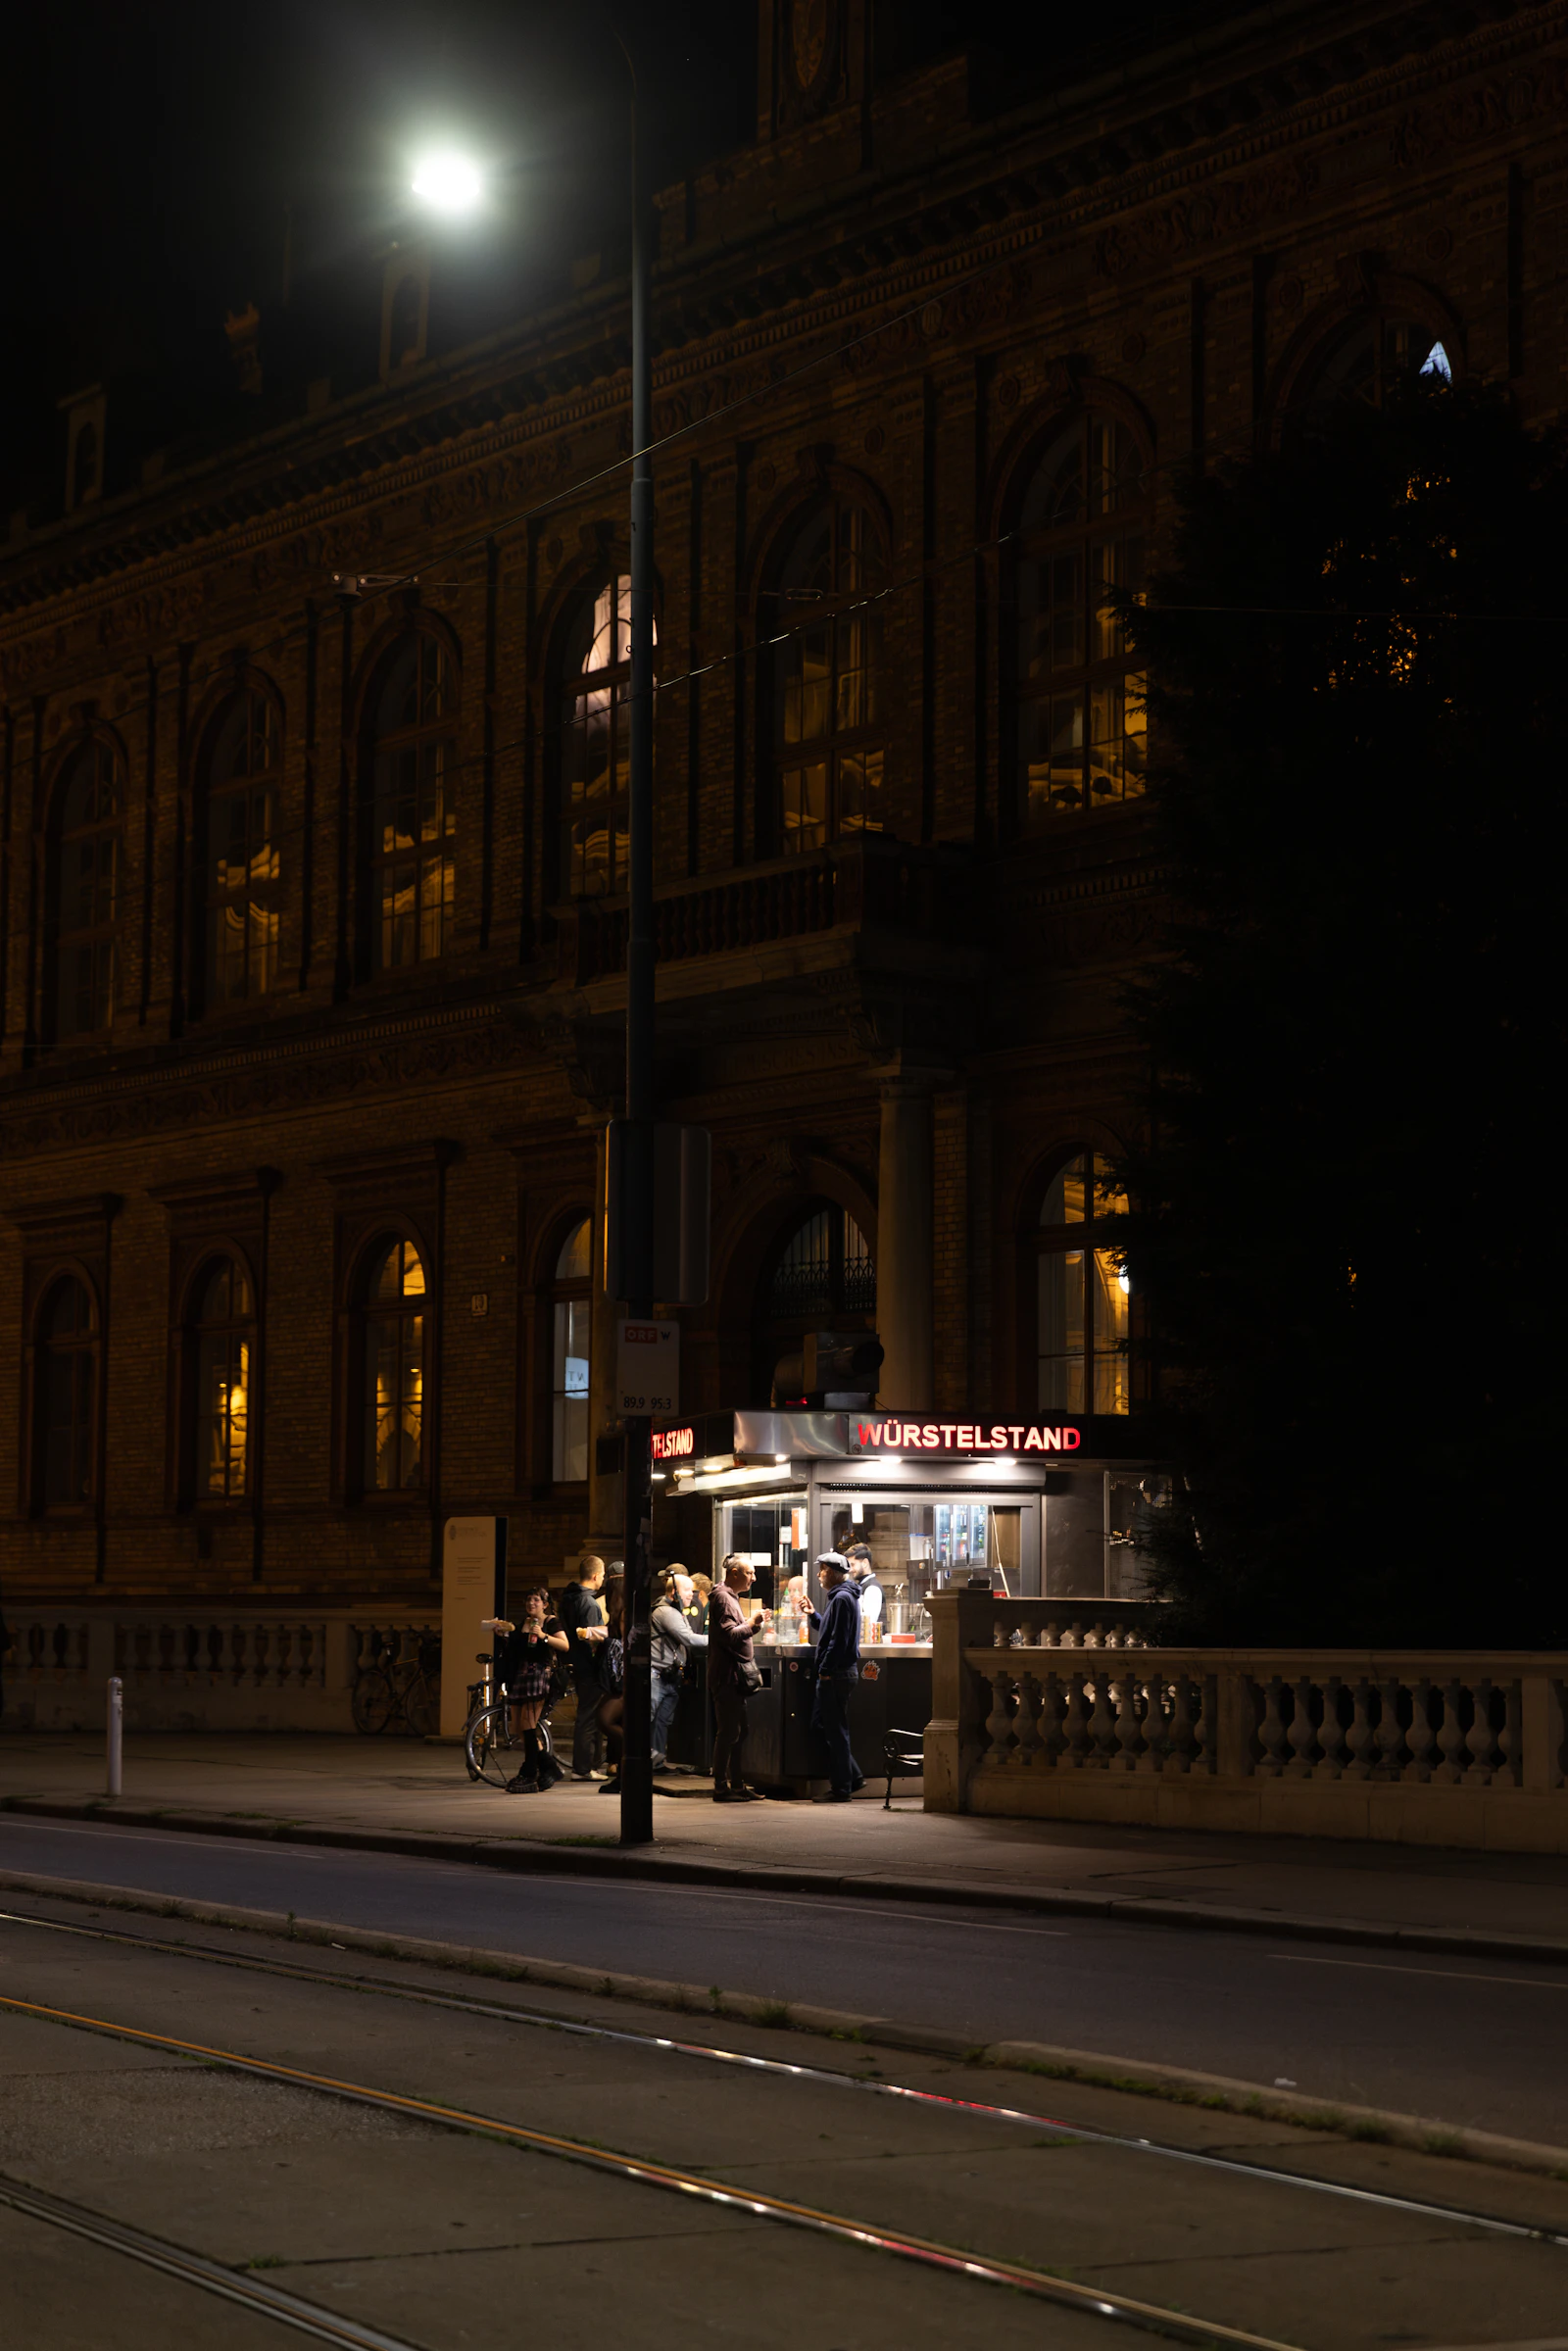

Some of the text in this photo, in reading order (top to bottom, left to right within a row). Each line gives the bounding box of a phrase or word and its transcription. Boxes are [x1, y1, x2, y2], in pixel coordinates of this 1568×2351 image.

[626, 1328, 671, 1342] ORF W
[623, 1396, 671, 1410] 89.9 95.3
[858, 1419, 1081, 1450] WÜRSTELSTAND
